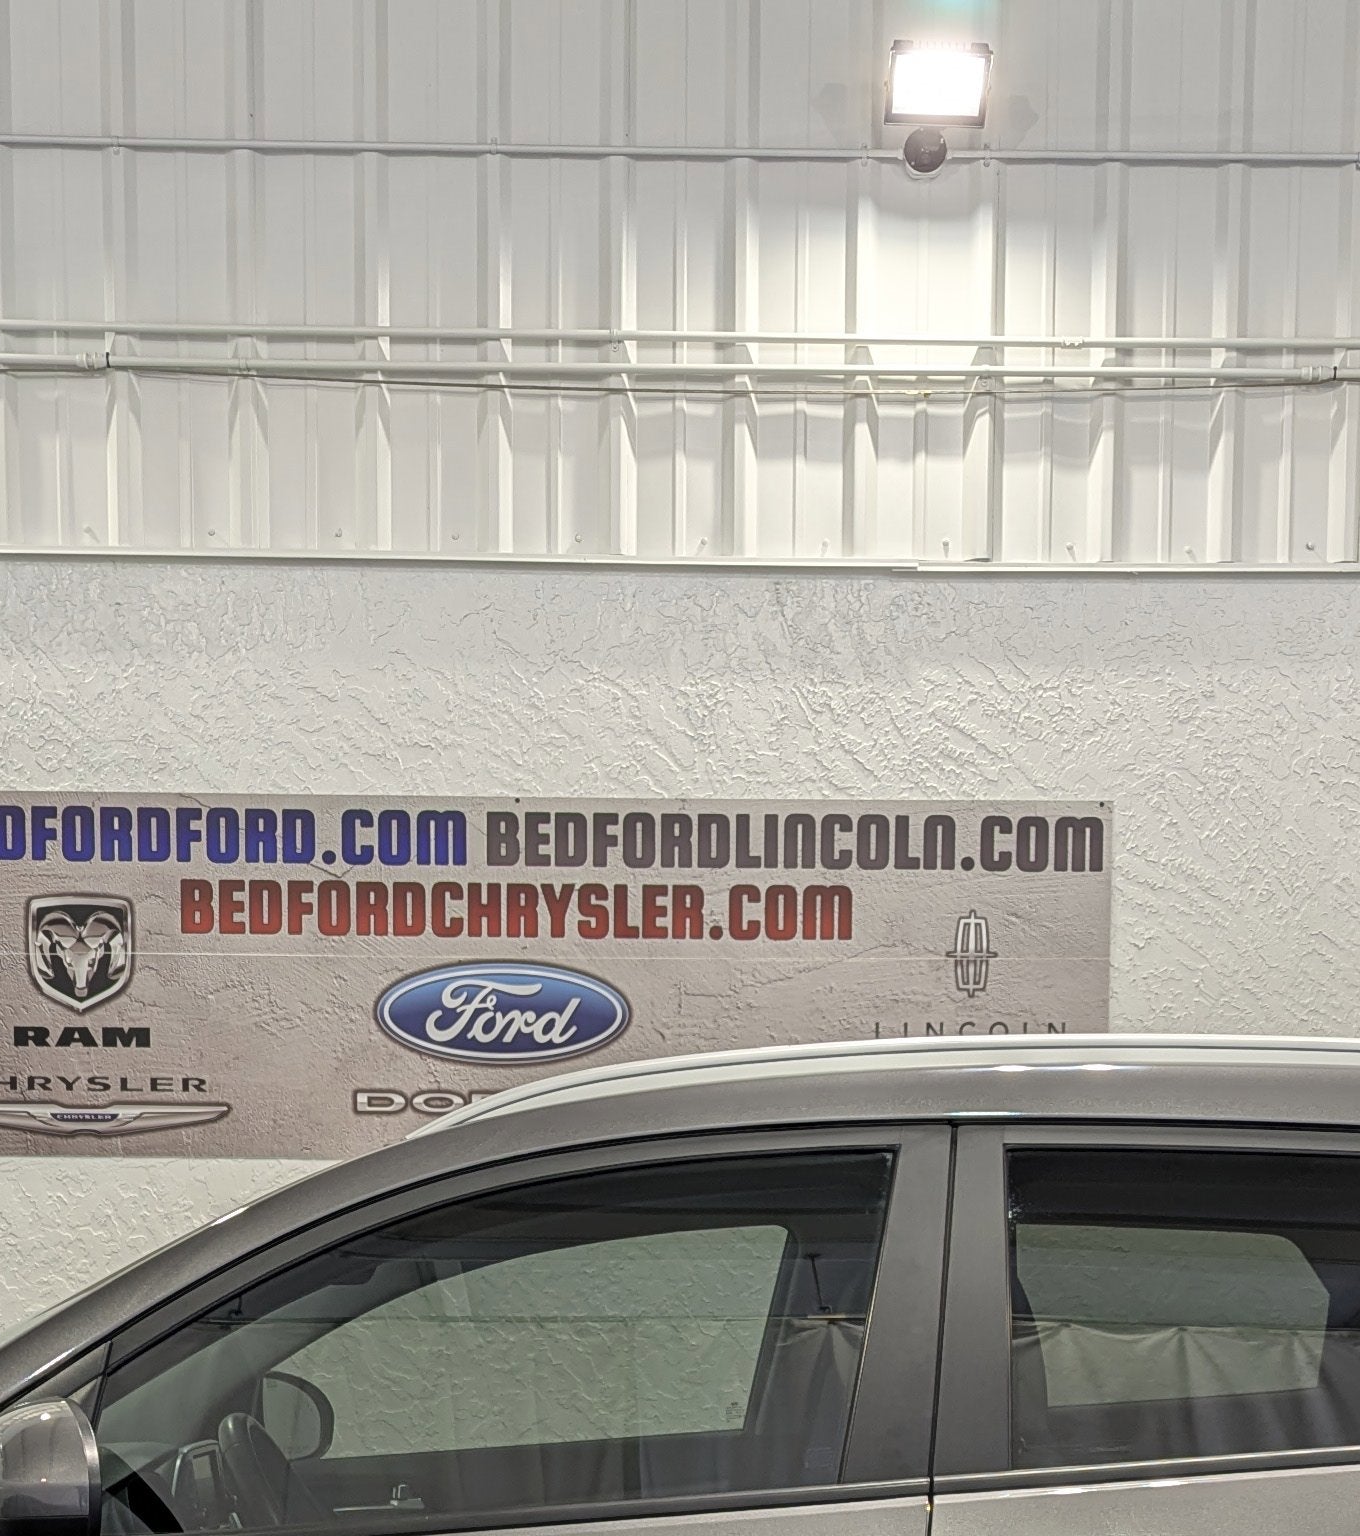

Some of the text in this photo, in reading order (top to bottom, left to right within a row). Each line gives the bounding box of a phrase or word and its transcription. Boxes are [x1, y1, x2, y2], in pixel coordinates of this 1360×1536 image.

[487, 810, 1105, 873] BEDFORDLINCOLN.COM
[180, 877, 854, 942] BEDFORDCHRYSLER.COM
[13, 1026, 151, 1048] RAM
[425, 979, 582, 1044] Ford
